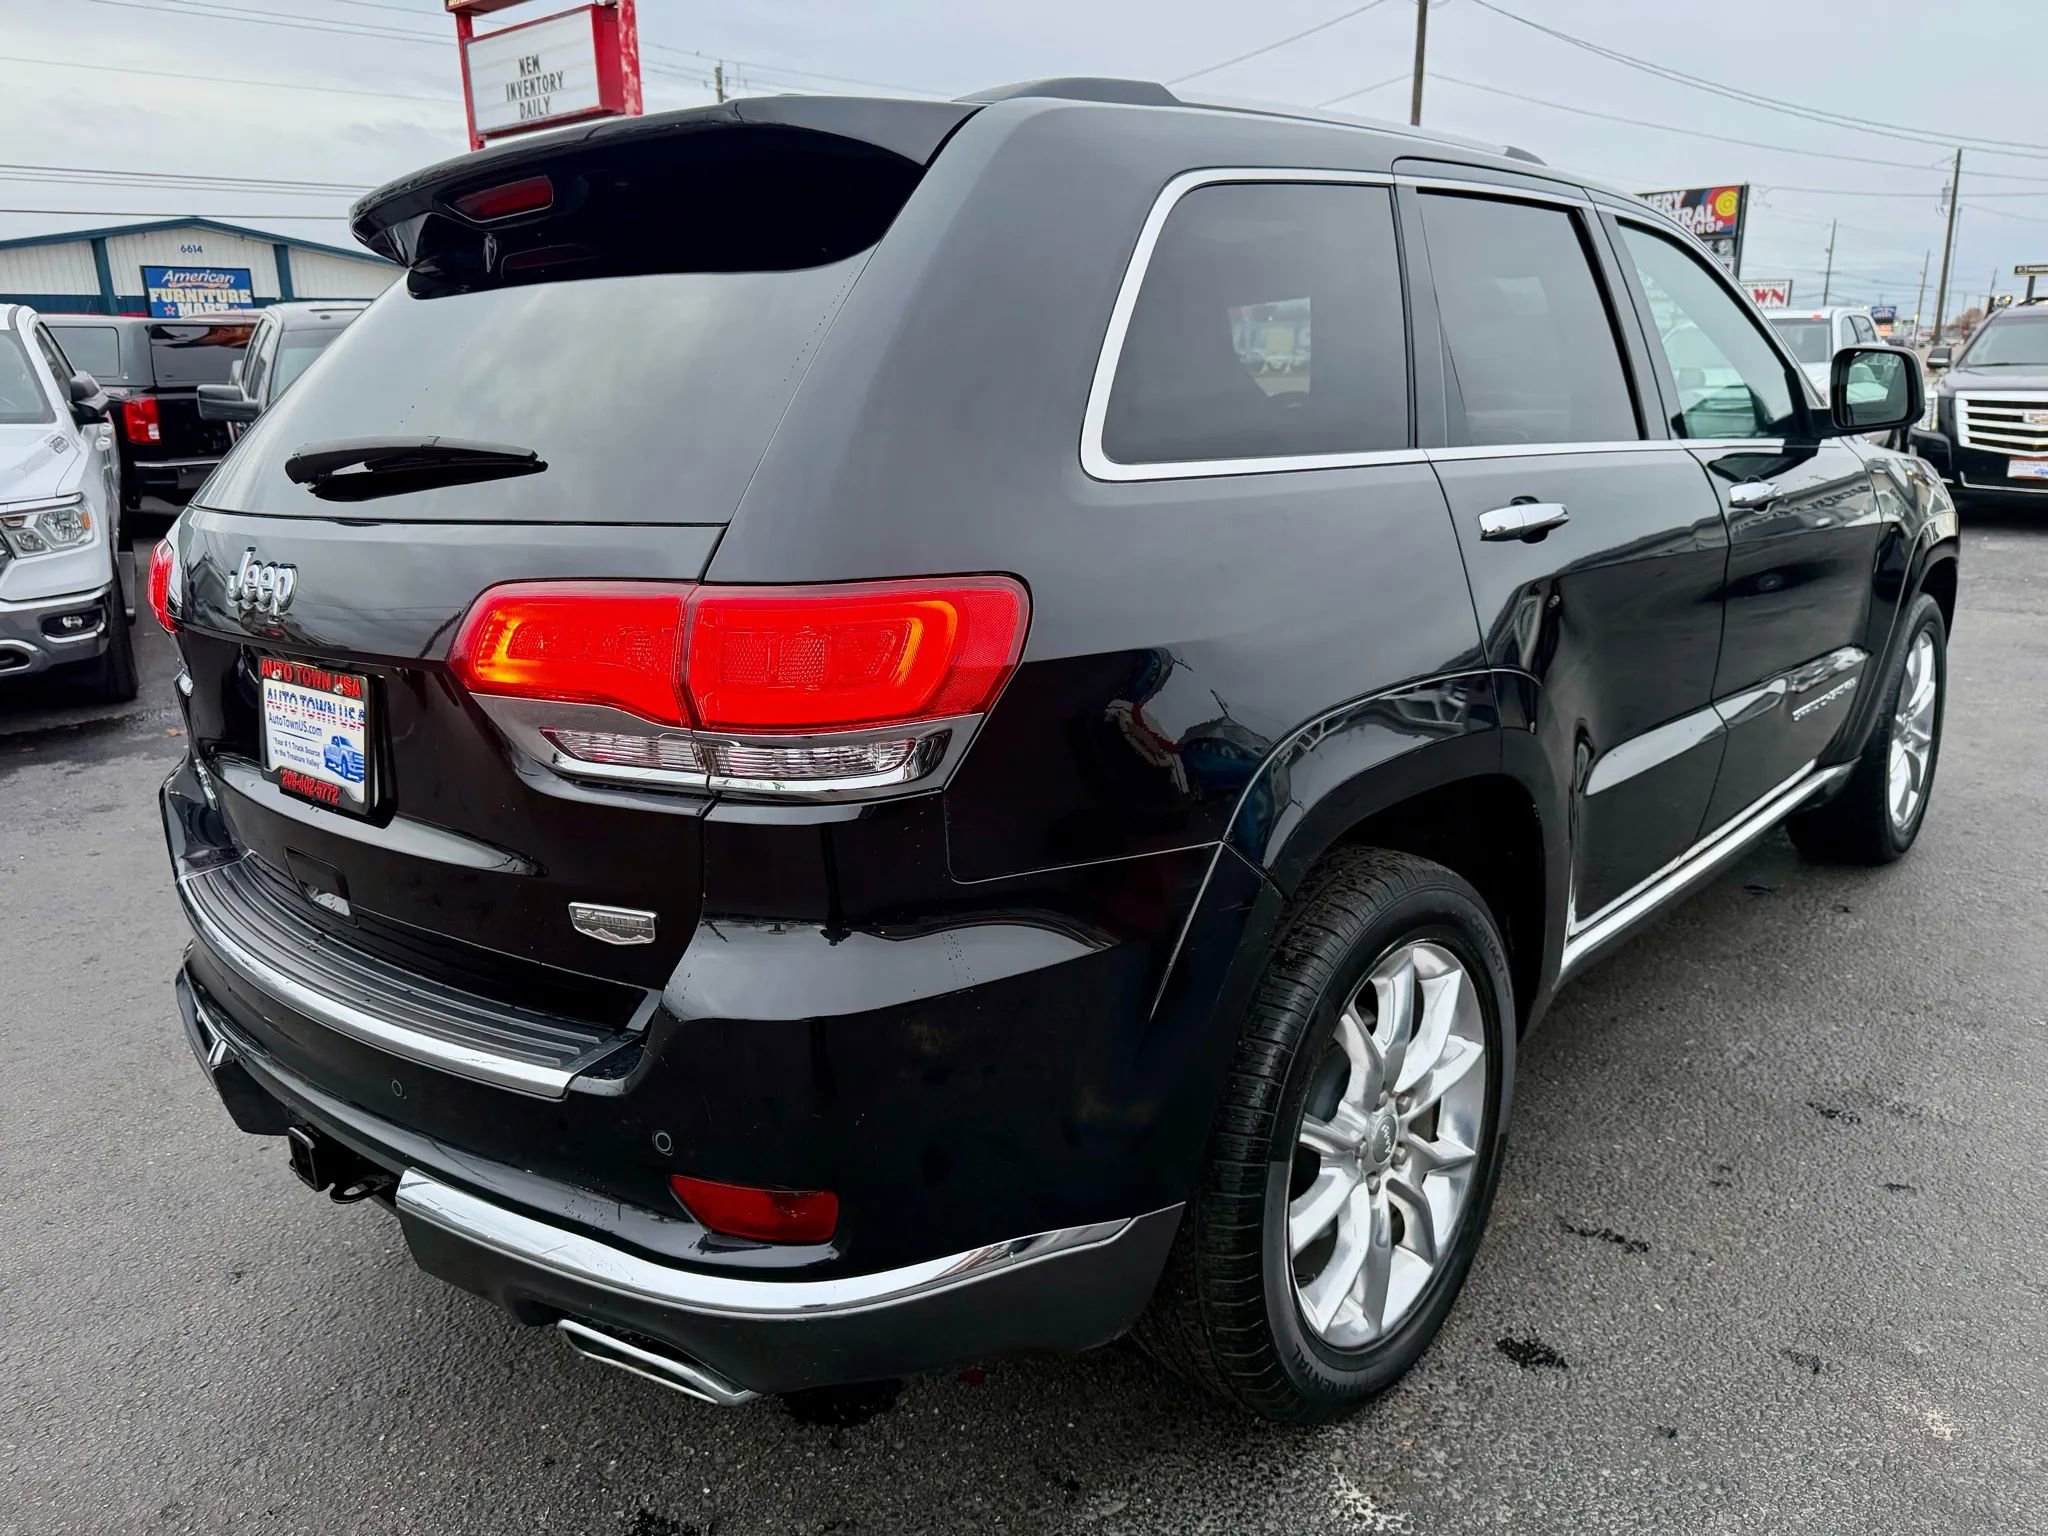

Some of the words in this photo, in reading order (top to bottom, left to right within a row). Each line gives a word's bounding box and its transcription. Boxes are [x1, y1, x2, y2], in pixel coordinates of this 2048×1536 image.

[518, 54, 541, 77] NEW
[505, 71, 564, 103] INVENTORY
[519, 96, 551, 120] DAILY
[180, 244, 203, 254] 6614
[161, 269, 236, 284] American
[148, 288, 253, 303] FURNITURE
[177, 302, 229, 317] MART
[226, 547, 298, 614] Jeep
[261, 659, 294, 682] AUTO
[296, 666, 332, 690] TOWN
[334, 674, 362, 698] USA
[267, 687, 299, 714] AUTO
[300, 694, 337, 725] TOWN
[268, 711, 323, 737] AutoTownUS.com
